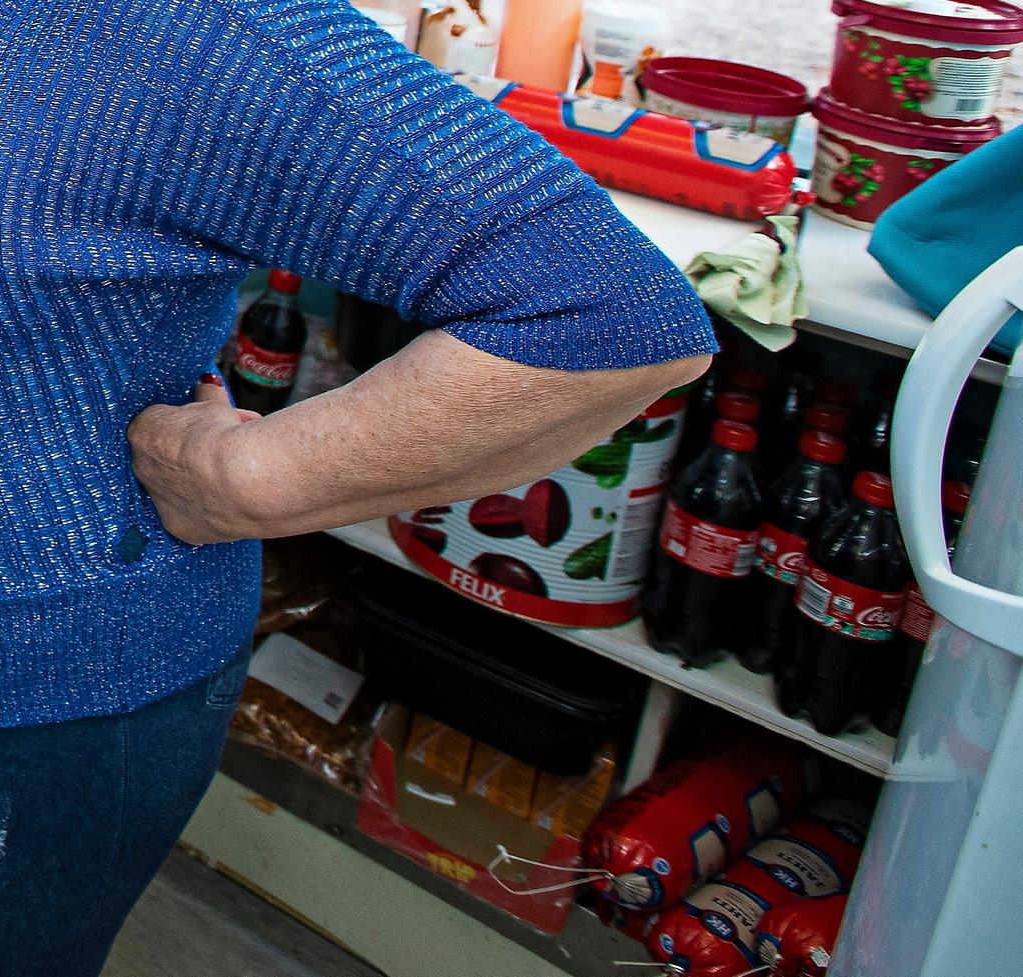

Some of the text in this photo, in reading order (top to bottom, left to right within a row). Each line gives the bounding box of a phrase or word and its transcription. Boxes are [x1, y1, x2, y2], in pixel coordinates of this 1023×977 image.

[450, 567, 506, 605] FELIX
[772, 866, 800, 890] HK
[704, 913, 733, 937] HK
